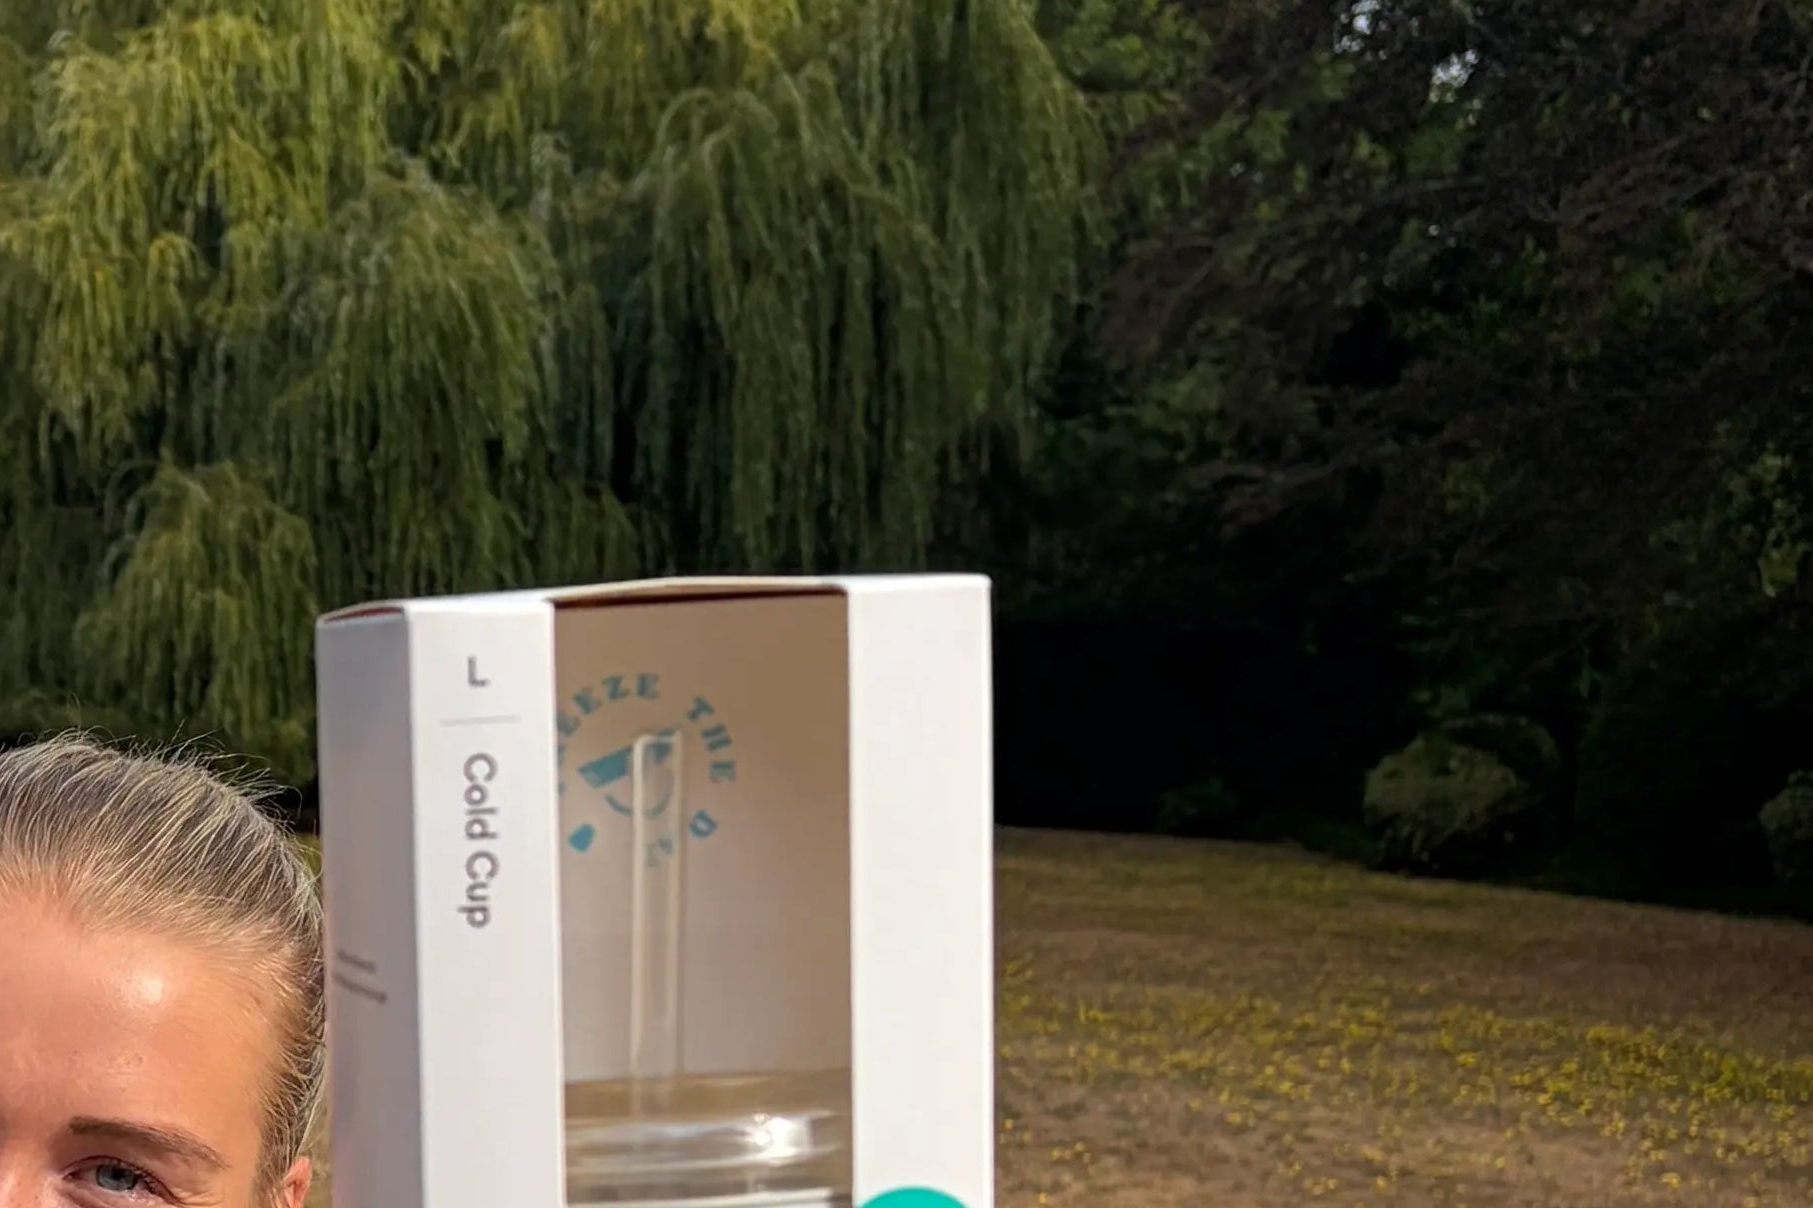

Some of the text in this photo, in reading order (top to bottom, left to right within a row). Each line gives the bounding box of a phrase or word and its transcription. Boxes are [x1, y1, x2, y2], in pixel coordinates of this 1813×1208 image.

[467, 655, 491, 688] L
[687, 695, 736, 784] THE
[456, 751, 500, 929] Cold Cup
